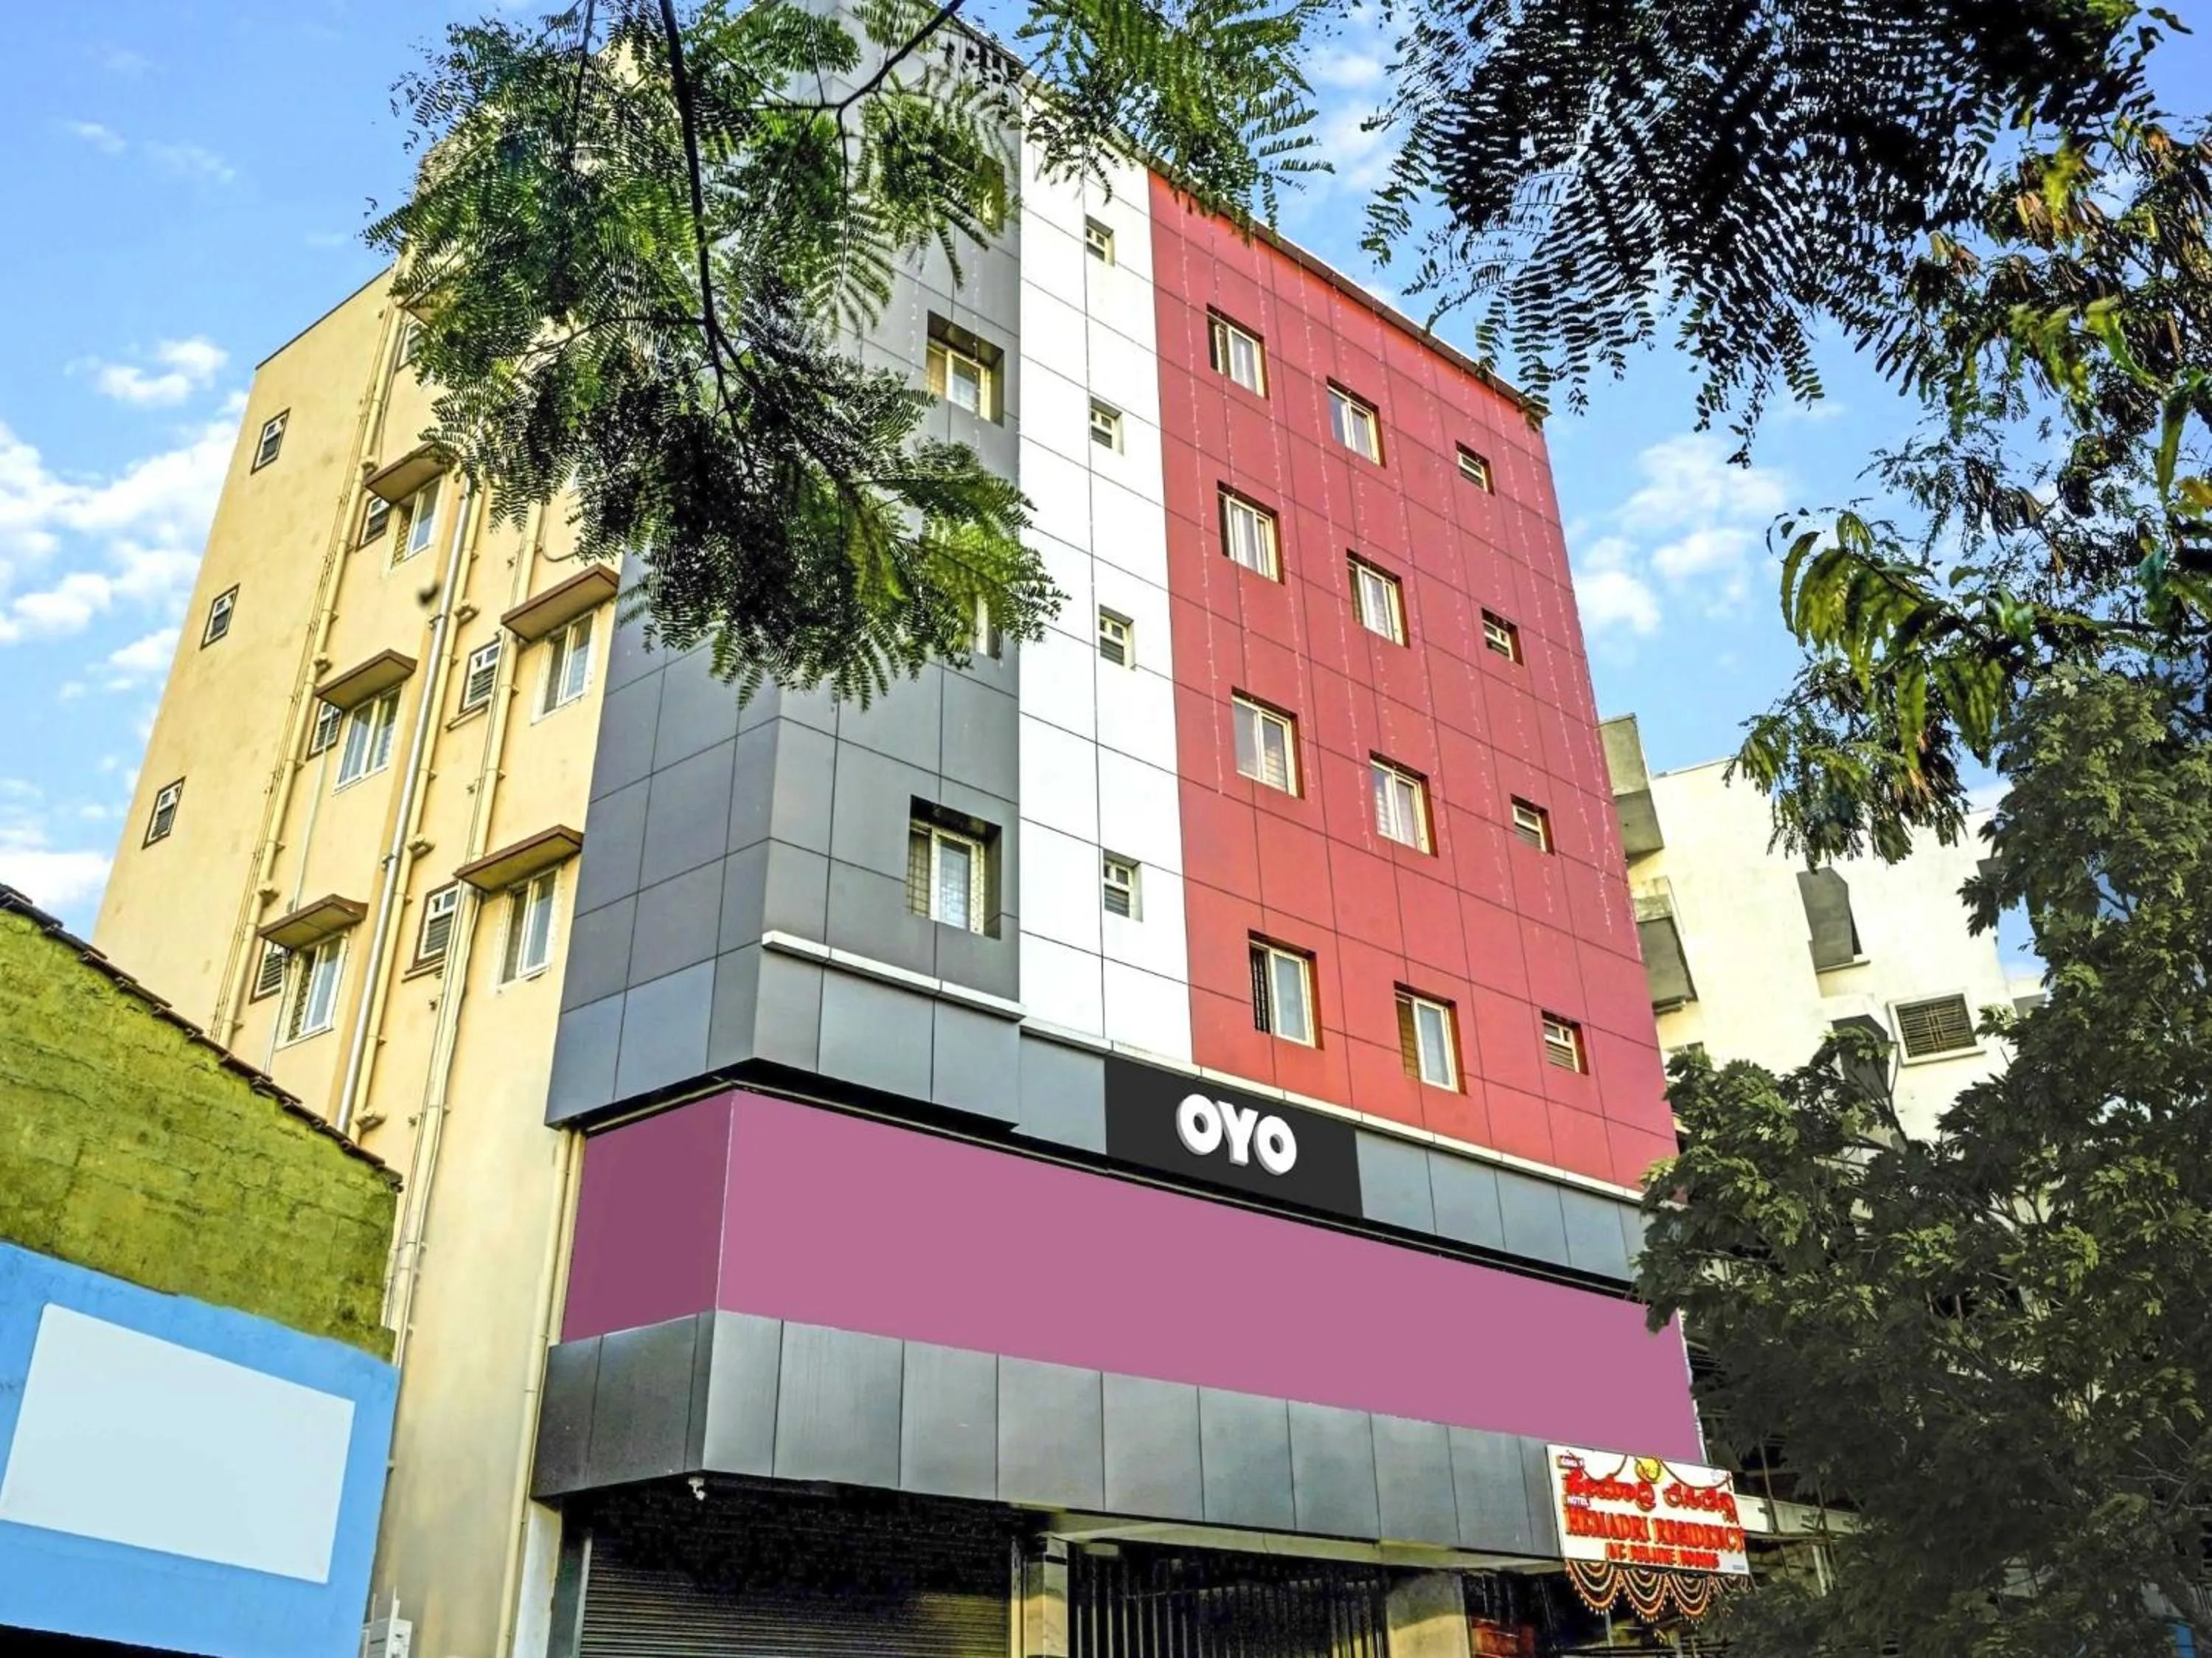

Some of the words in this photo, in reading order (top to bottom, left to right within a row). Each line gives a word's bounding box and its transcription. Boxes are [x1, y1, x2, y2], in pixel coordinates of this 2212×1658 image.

[1176, 1093, 1297, 1175] OYO
[1567, 1496, 1590, 1507] HOTEL
[1652, 1518, 1745, 1553] RESIDENCY
